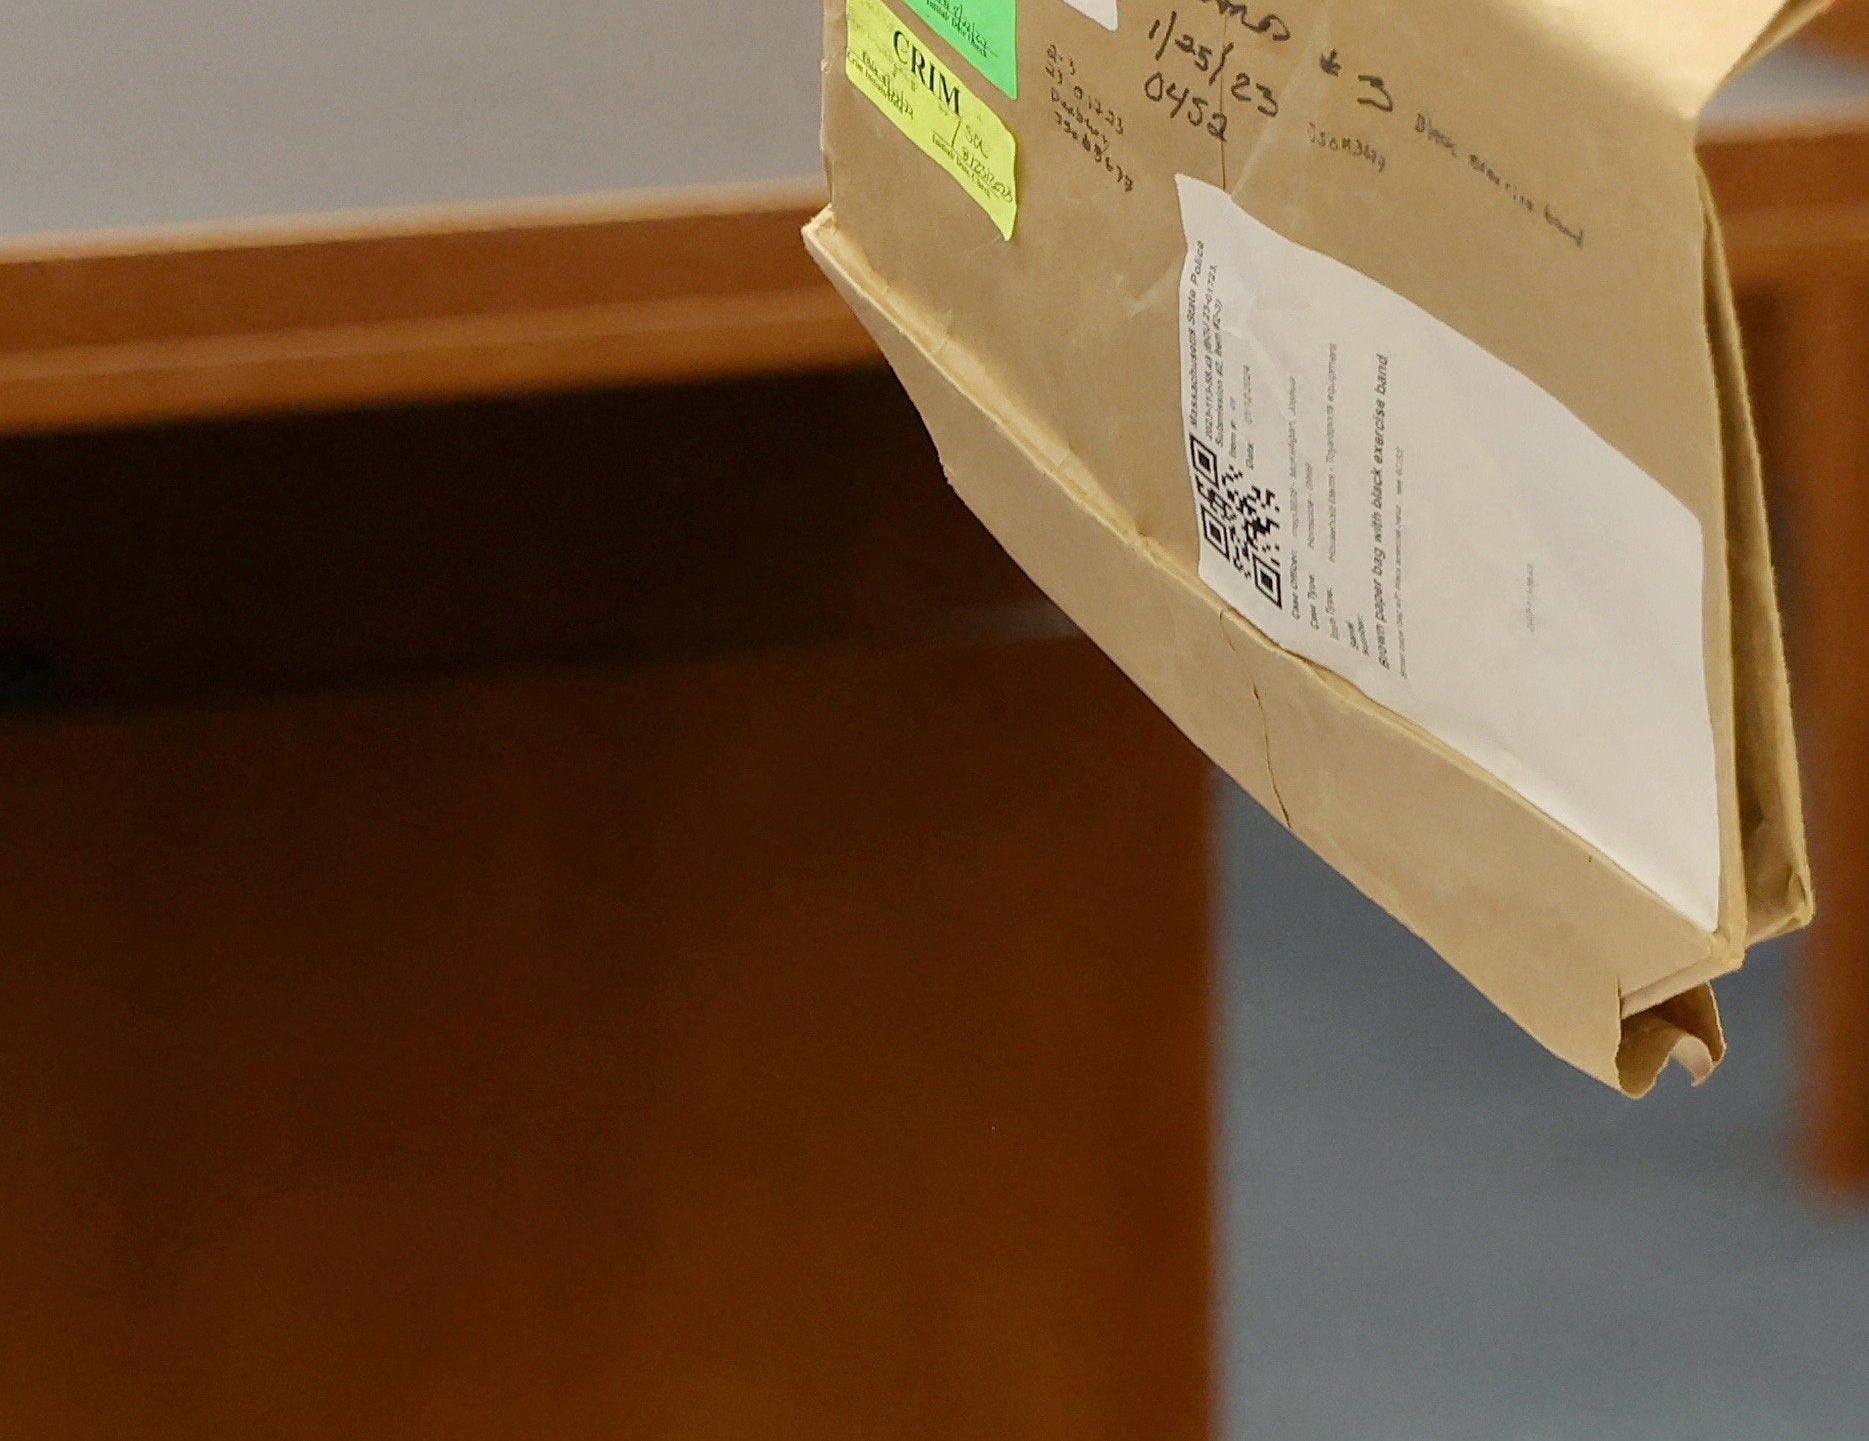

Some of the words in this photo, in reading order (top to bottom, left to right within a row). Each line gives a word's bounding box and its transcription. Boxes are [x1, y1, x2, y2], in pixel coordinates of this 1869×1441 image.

[893, 30, 961, 117] CRIM
[1148, 10, 1279, 117] 1/25/23
[1144, 71, 1228, 142] 0452
[1189, 239, 1204, 286] Police
[1187, 288, 1196, 326] State
[1374, 353, 1388, 396] band
[1372, 398, 1385, 465] exercise
[1370, 467, 1383, 508] black
[1371, 512, 1383, 543] with
[1371, 548, 1385, 577] bag
[1371, 579, 1387, 624] paper
